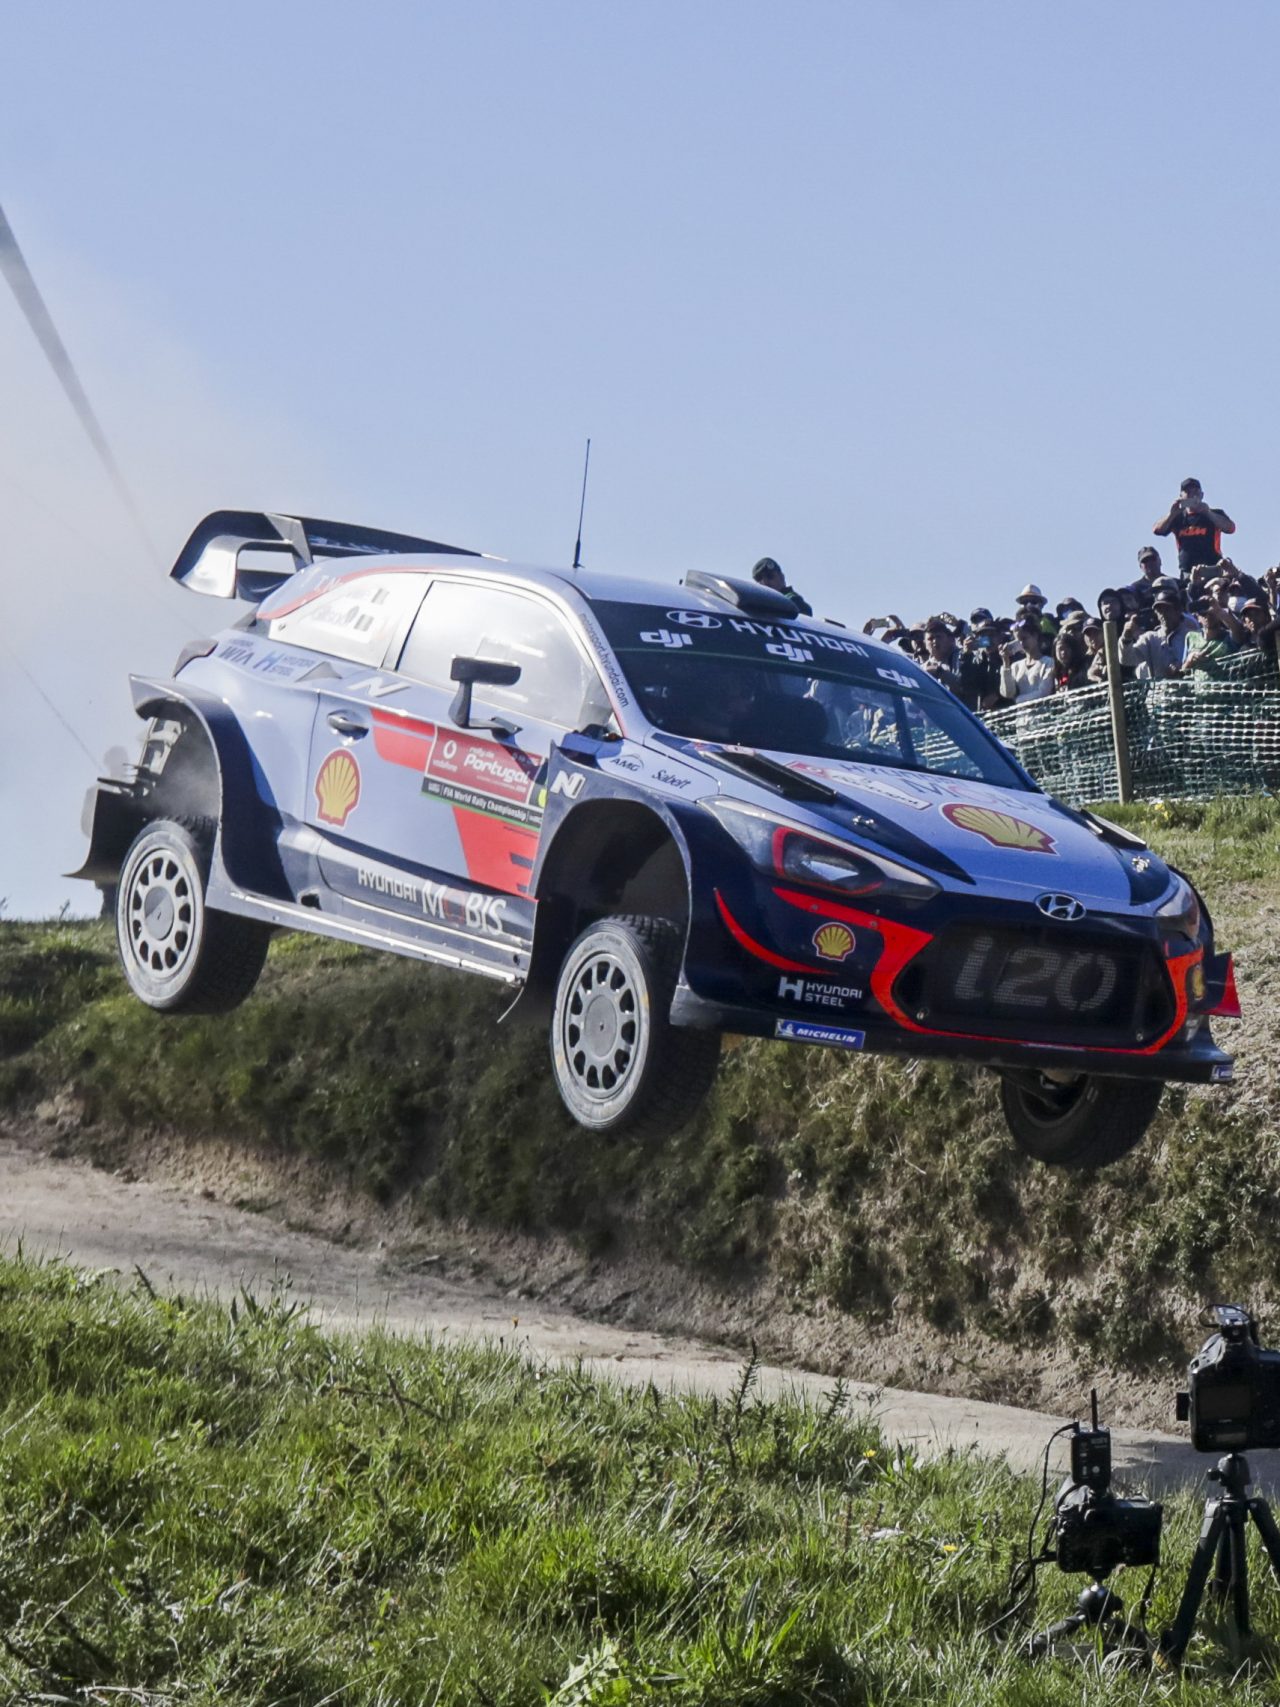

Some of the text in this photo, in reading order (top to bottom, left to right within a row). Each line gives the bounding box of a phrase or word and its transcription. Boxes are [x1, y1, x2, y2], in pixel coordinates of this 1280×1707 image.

[729, 618, 870, 659] HYUNDAI
[219, 647, 256, 666] WIA
[463, 752, 529, 785] Portugal
[443, 786, 454, 797] FIA
[454, 789, 472, 803] World
[471, 795, 487, 809] Rally
[487, 798, 527, 822] Championship
[358, 867, 507, 936] HYUNDAI MOBIS
[806, 982, 862, 999] HYUNDAI
[954, 936, 1117, 1012] i20
[805, 993, 845, 1007] STEEL
[796, 1028, 857, 1043] MICHELIN
